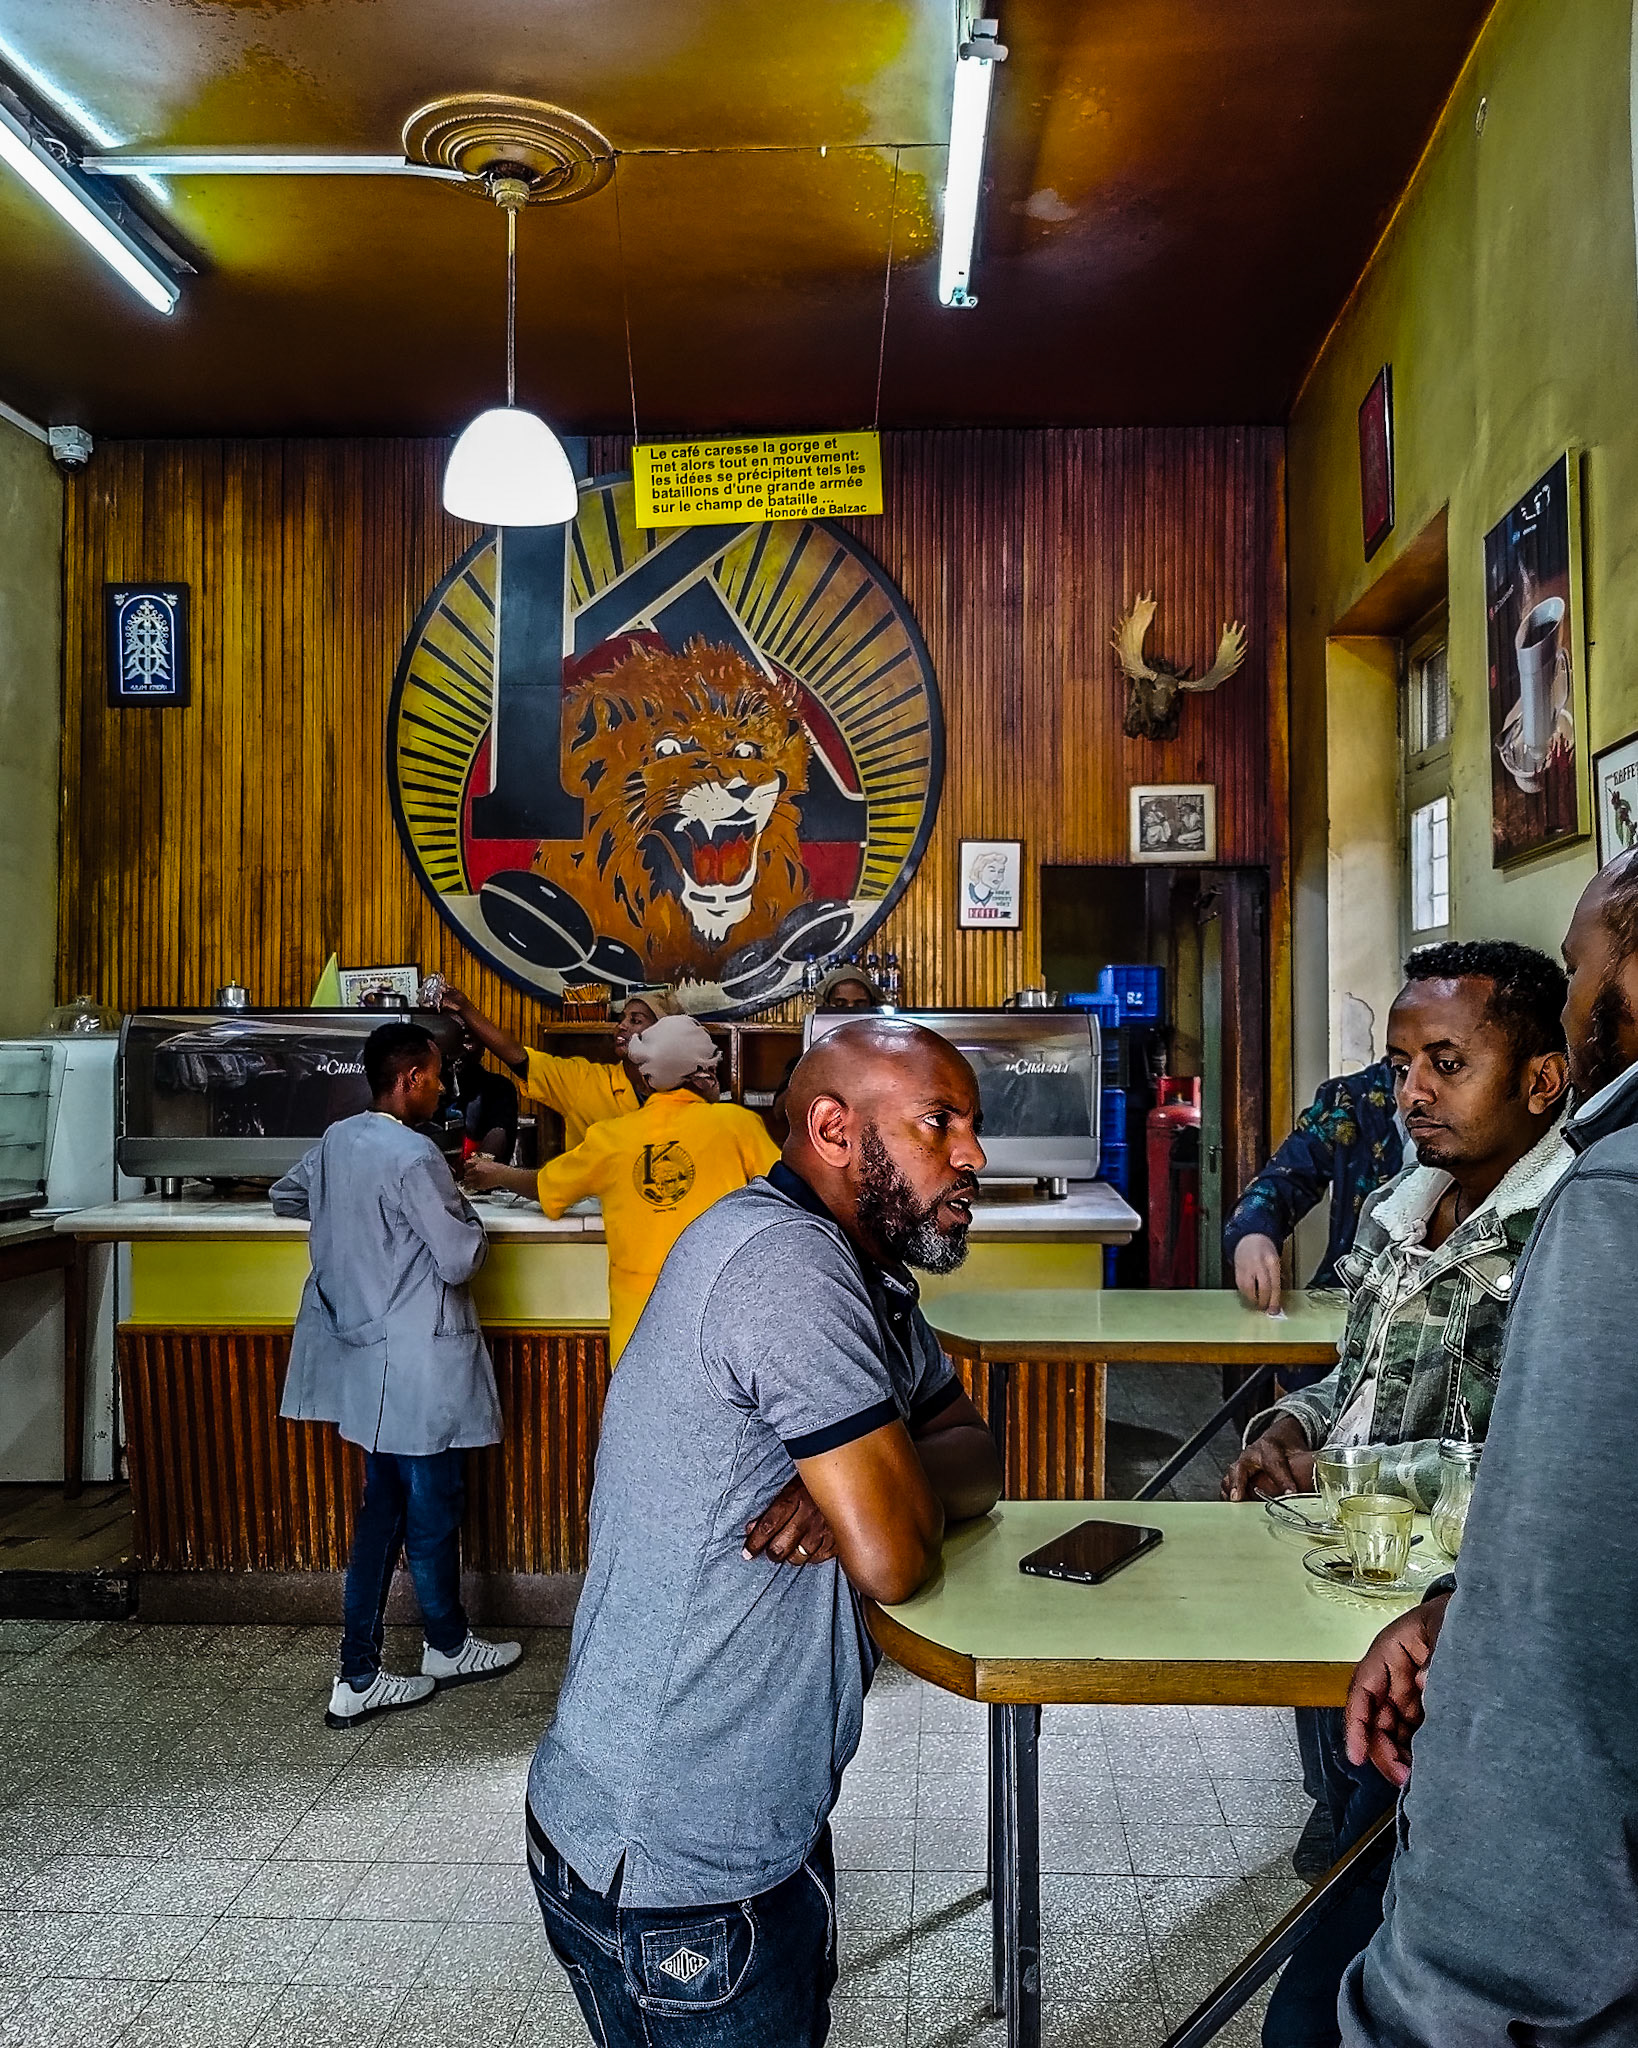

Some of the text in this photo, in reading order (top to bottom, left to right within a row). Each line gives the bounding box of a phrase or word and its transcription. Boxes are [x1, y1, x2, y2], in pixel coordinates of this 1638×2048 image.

[650, 437, 838, 459] Le café caresse la gorge et
[651, 449, 859, 473] met alors tout en mouvement:
[651, 463, 866, 486] les idées se précipitent tels les
[652, 475, 863, 499] bataillons d'une grande armée
[652, 503, 675, 514] sur
[679, 500, 691, 512] le
[695, 499, 743, 512] champ
[746, 496, 763, 508] de
[768, 492, 818, 507] bataille
[765, 503, 868, 518] Honoré de Balzac
